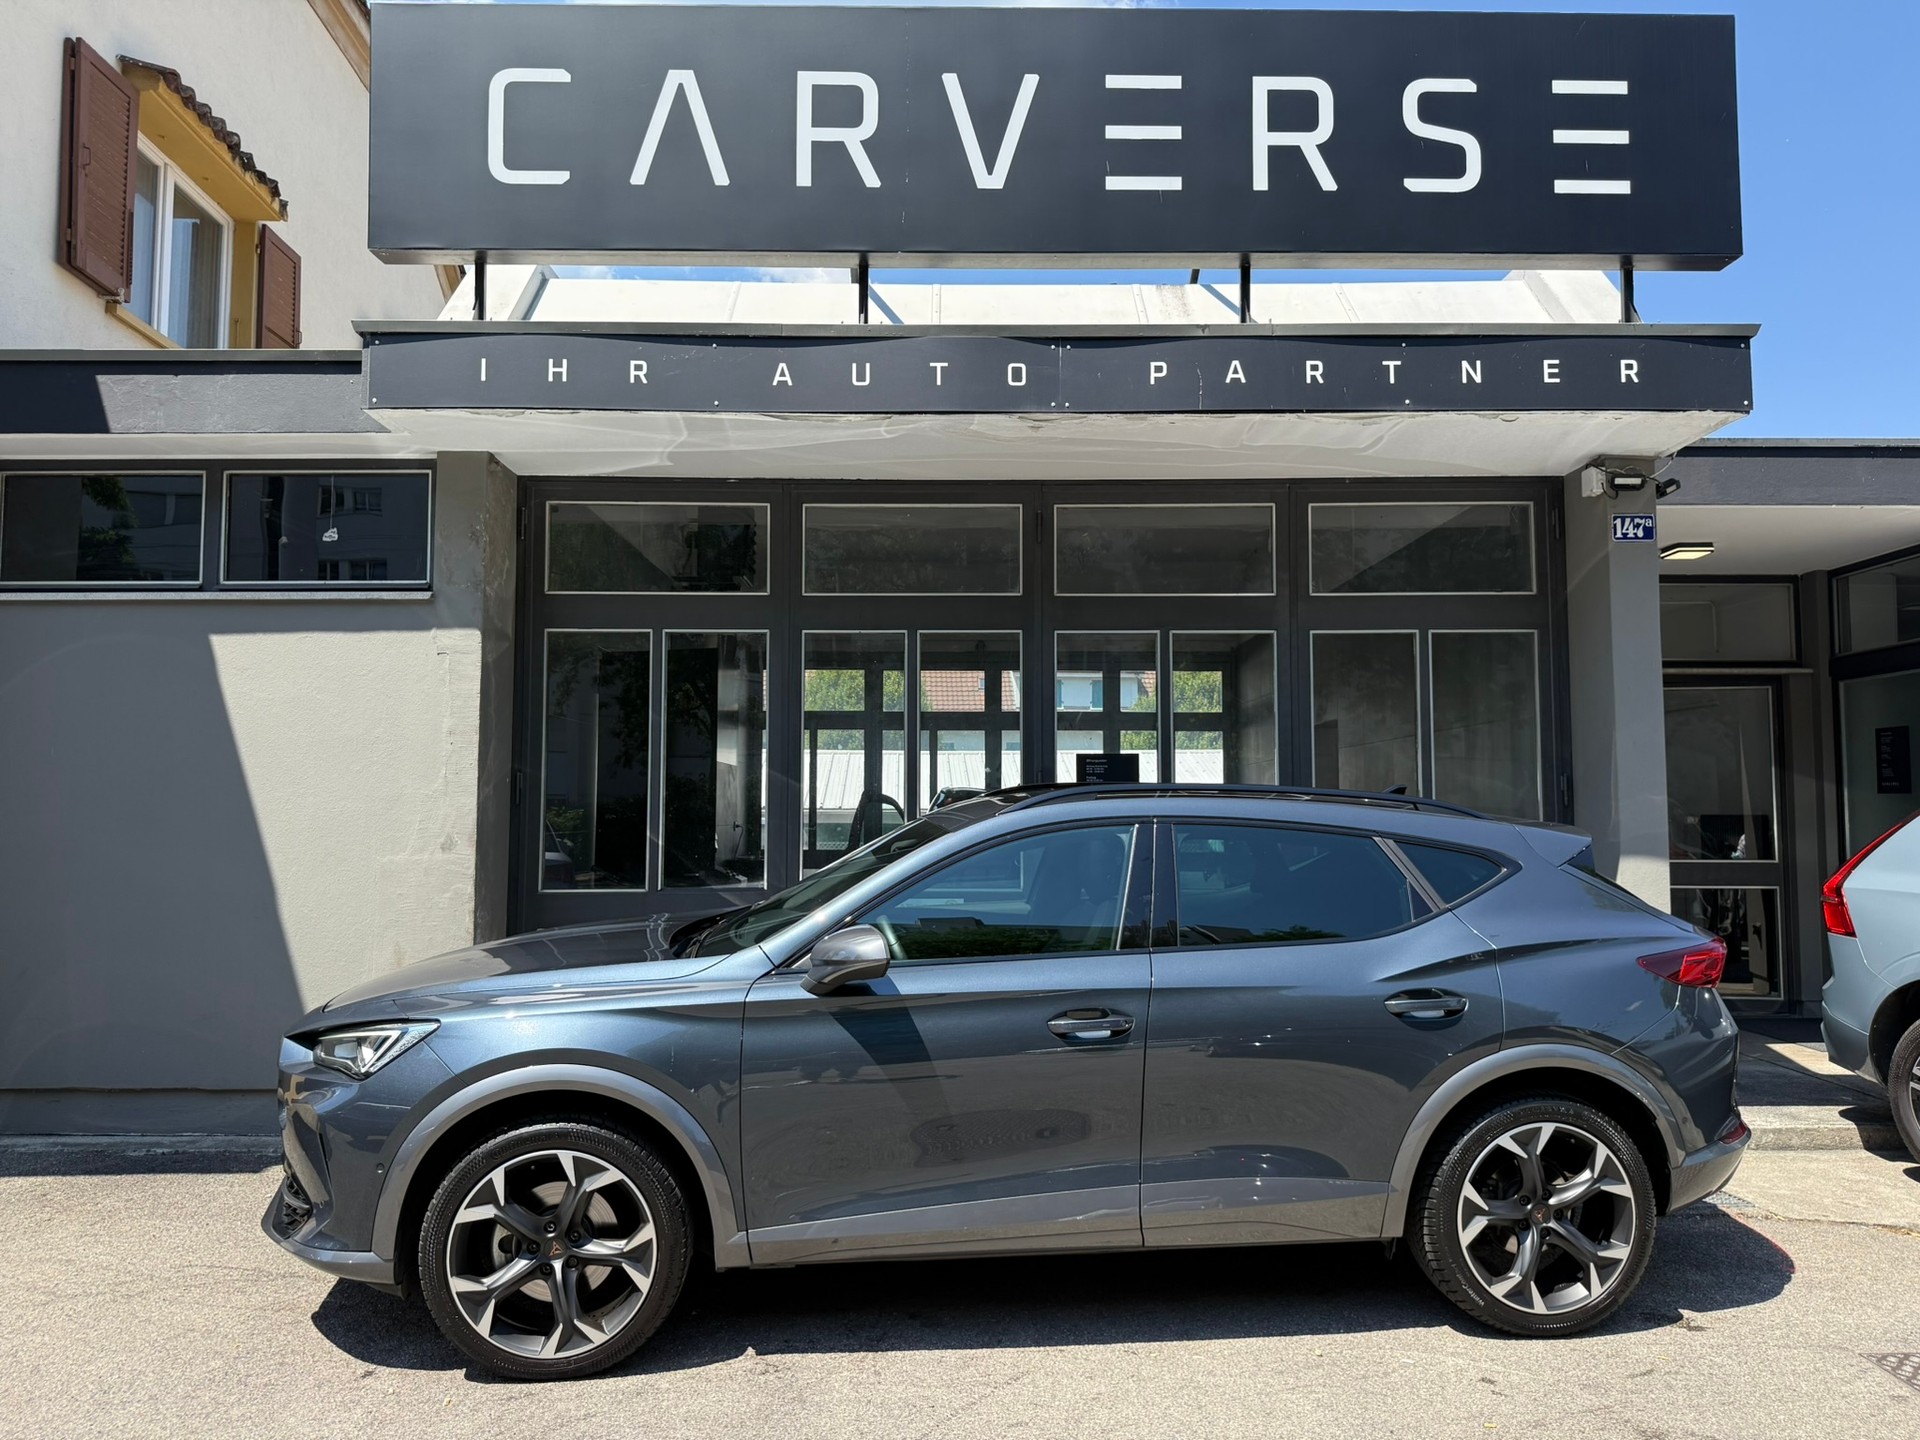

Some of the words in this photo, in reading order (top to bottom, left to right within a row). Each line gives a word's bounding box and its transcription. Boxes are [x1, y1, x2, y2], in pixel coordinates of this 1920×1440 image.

[488, 68, 1632, 195] CARVERSE
[480, 357, 649, 385] IHR
[771, 361, 1027, 387] AUTO
[1149, 359, 1640, 386] PARTNER
[1613, 517, 1653, 538] 147a
